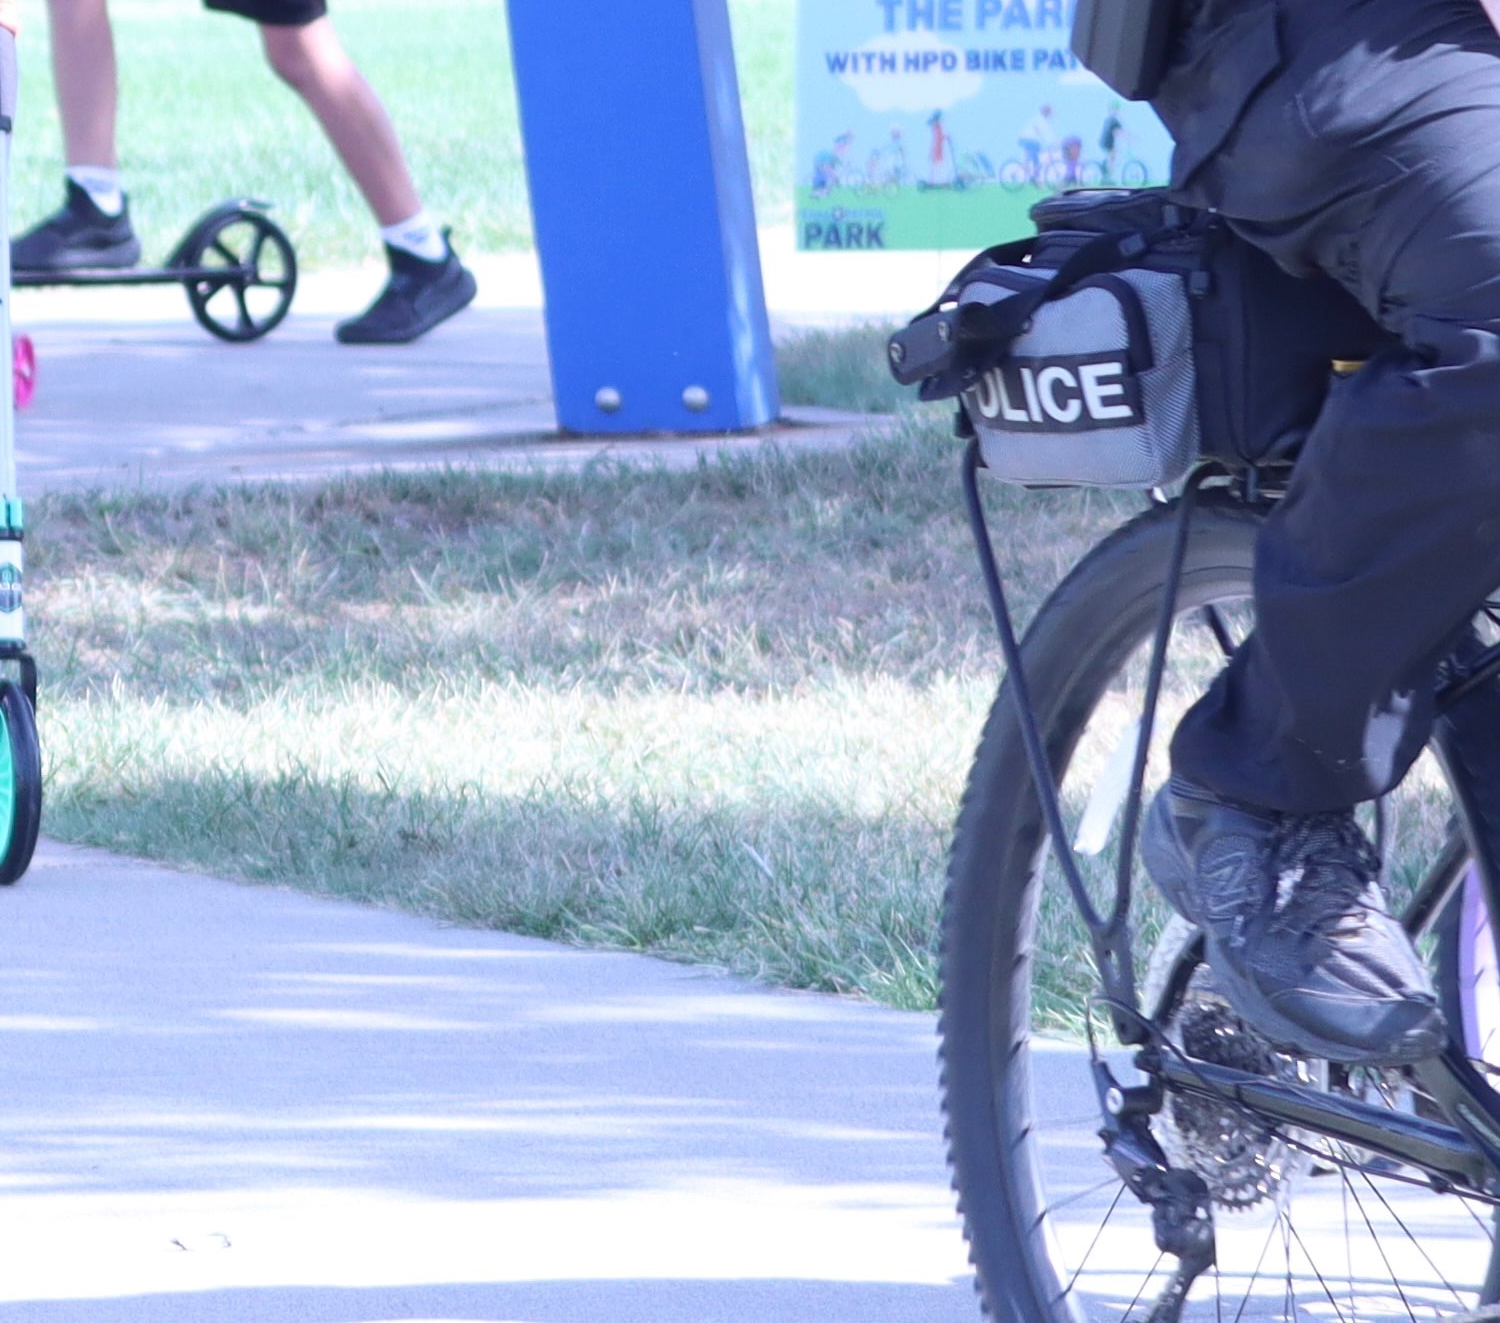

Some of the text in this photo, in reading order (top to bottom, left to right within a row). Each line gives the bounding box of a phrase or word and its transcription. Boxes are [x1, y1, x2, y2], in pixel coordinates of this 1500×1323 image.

[826, 48, 1081, 74] WITH HPD BIKE PAT
[804, 221, 885, 249] PARK
[961, 361, 1133, 424] OLICE
